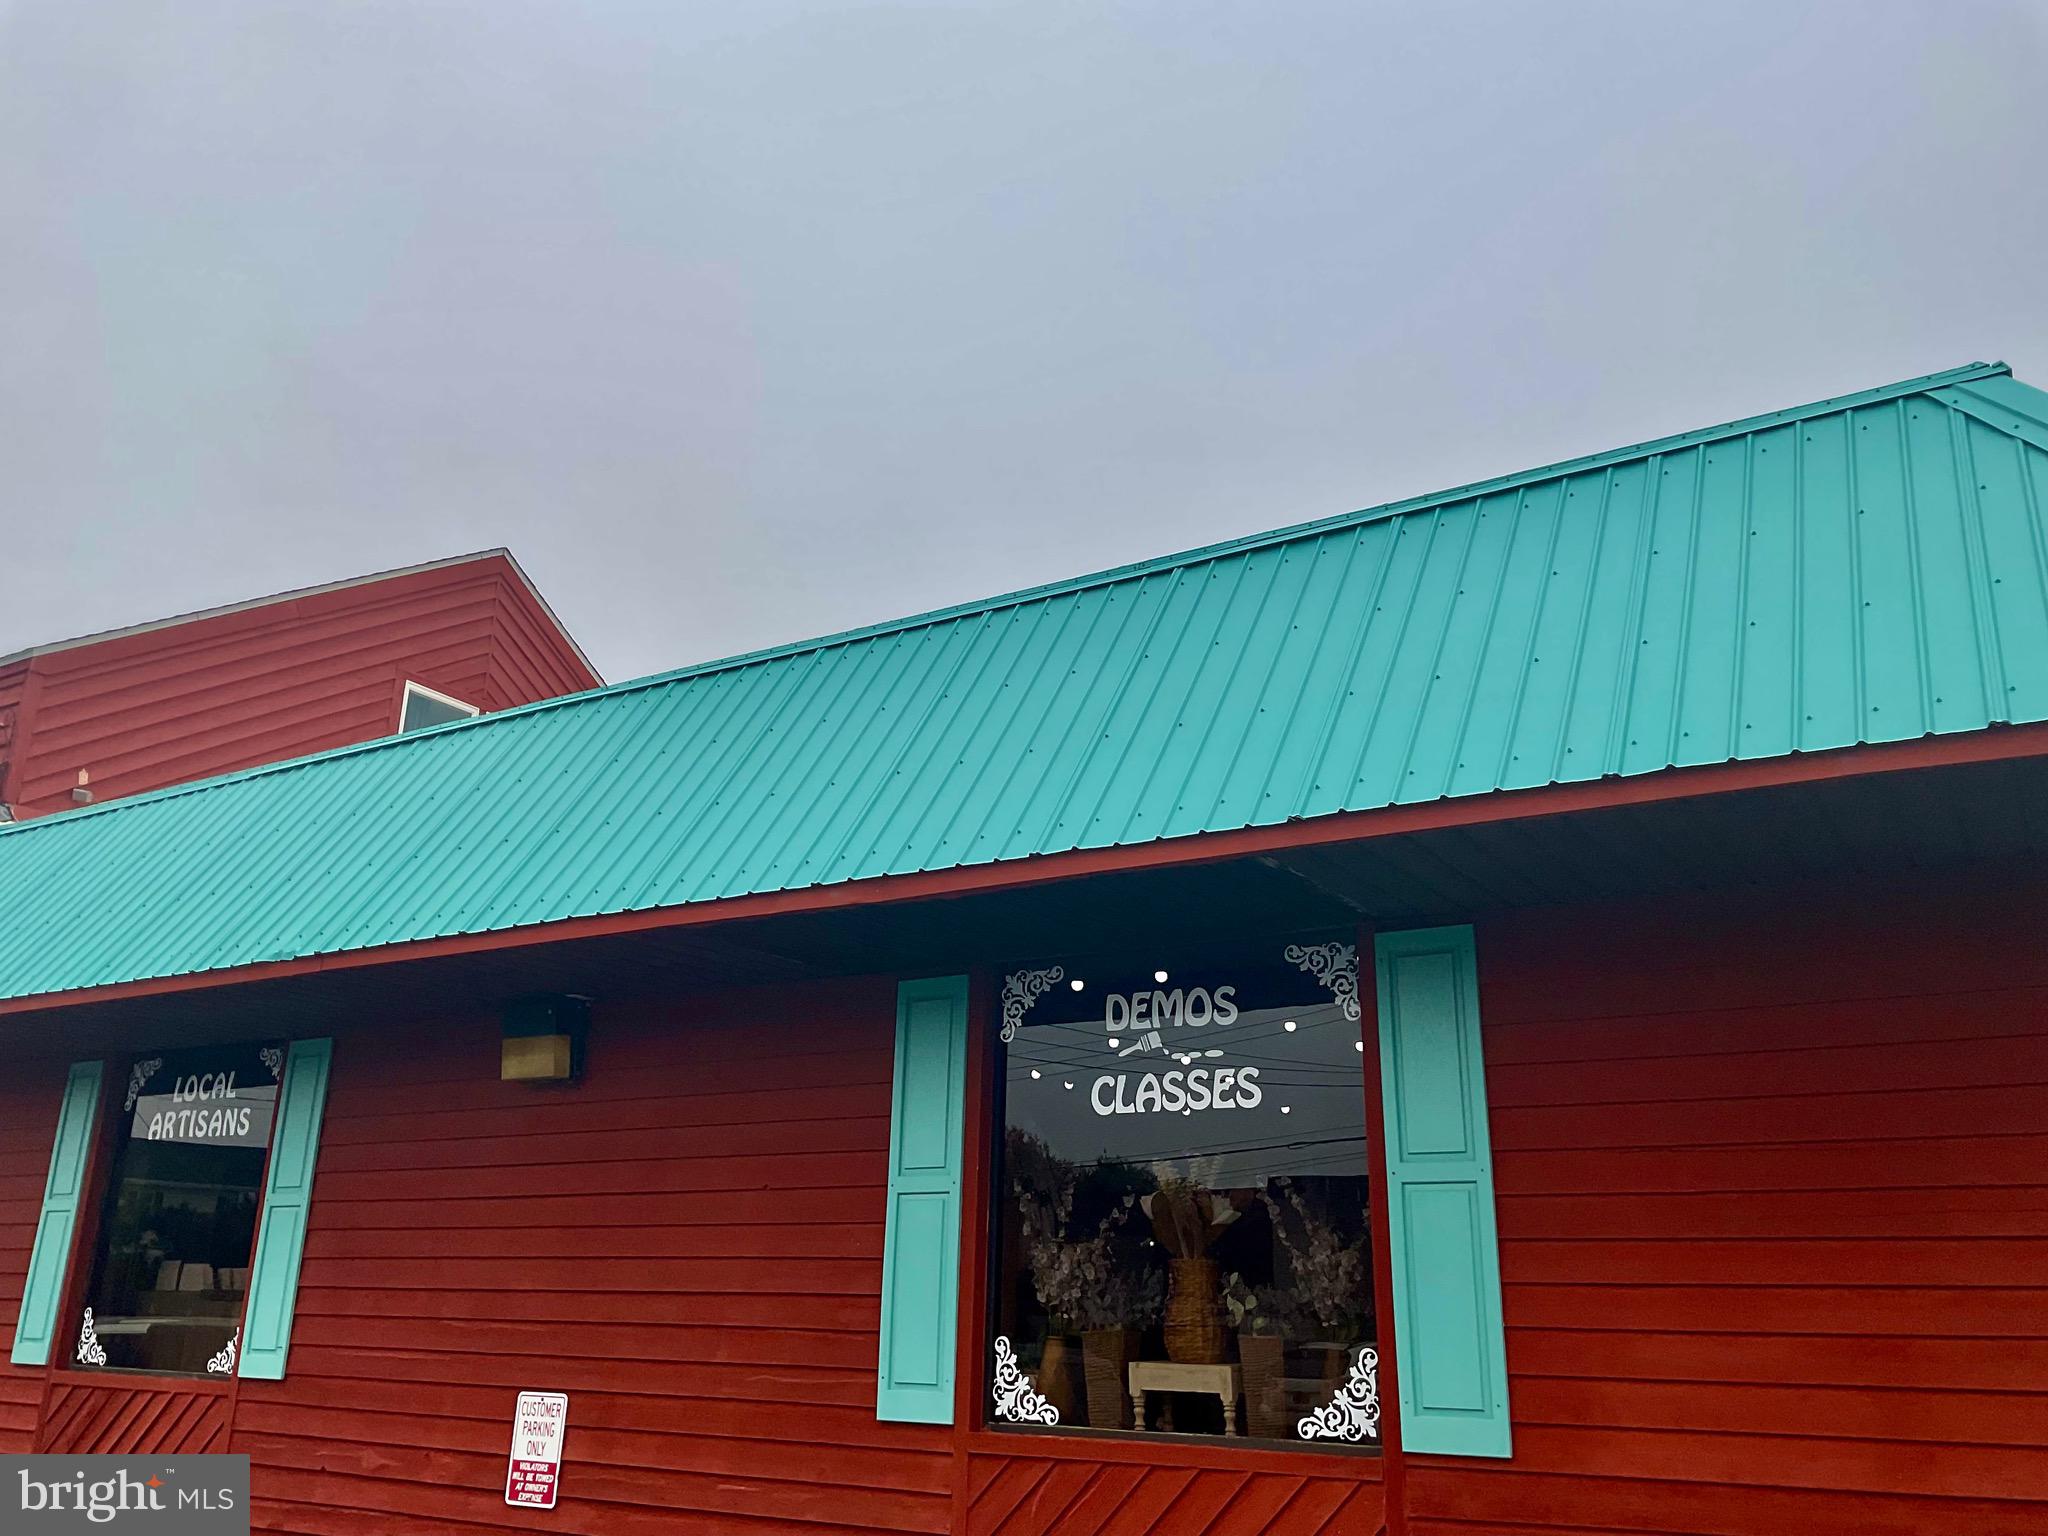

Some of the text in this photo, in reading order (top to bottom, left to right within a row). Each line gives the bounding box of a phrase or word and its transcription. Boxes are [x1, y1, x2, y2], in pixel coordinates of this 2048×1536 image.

[1105, 985, 1239, 1031] DEMOS
[172, 1070, 236, 1103] LOCAL
[1091, 1066, 1262, 1116] CLASSES
[147, 1107, 251, 1140] ARTISANS
[521, 1401, 561, 1417] CUSTOMER
[522, 1420, 554, 1437] PARKING
[526, 1440, 546, 1456] ONLY
[519, 1461, 548, 1472] VIOLATORS
